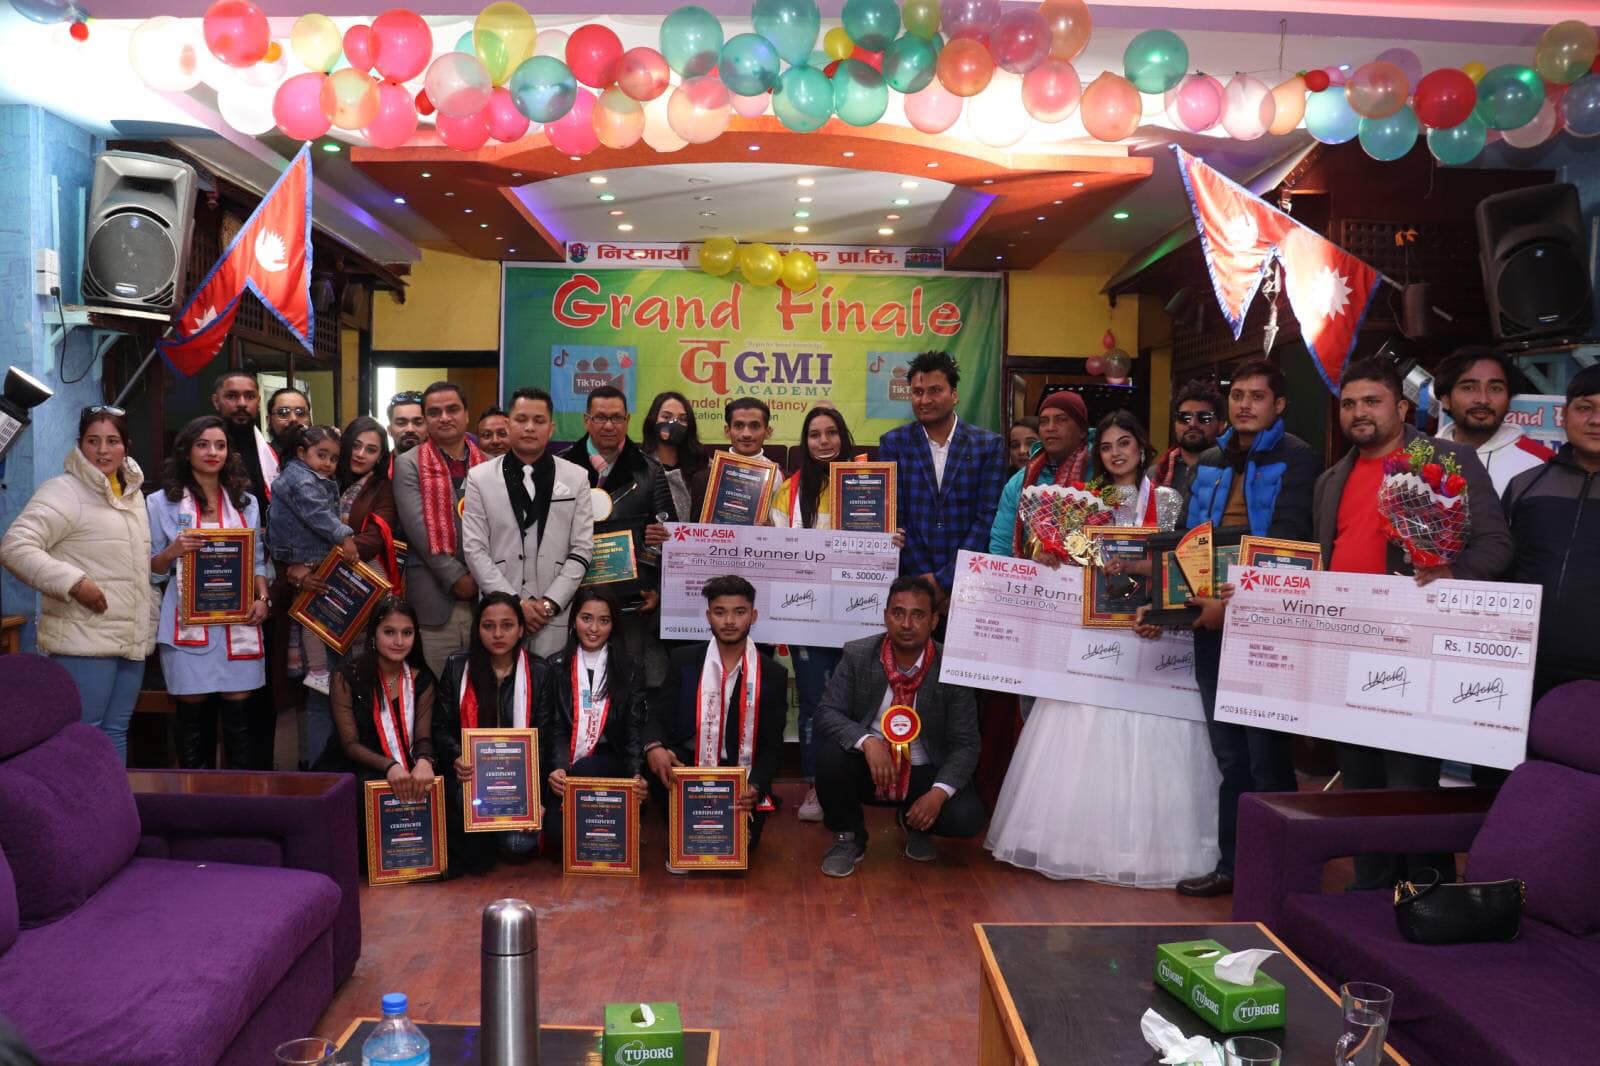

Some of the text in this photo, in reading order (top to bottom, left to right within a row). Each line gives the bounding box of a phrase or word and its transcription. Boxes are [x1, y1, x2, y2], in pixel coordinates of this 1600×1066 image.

[552, 273, 962, 337] Grand Finale
[734, 351, 833, 384] GMI
[576, 378, 607, 387] TikTok
[736, 385, 831, 396] ACADEMY
[1504, 408, 1544, 426] and
[692, 528, 736, 539] NIC ASIA
[708, 545, 826, 563] 2nd Runner Up
[709, 559, 746, 567] Thousand
[748, 560, 766, 569] Only
[990, 560, 1008, 572] NIC
[1011, 563, 1038, 577] ASIA
[841, 570, 888, 581] Rs. 50000/-
[1262, 574, 1311, 589] NIC ASIA
[1006, 581, 1083, 603] 1st Runn
[1038, 600, 1058, 611] Only
[1282, 599, 1346, 617] Winner
[1251, 613, 1386, 636] One Lakh Fifty Thousand Only
[1444, 639, 1525, 659] Rs. 150000/-
[1161, 964, 1184, 986] TUBORG
[1196, 989, 1219, 1015] TUBORG
[1240, 1003, 1280, 1018] TUBORG
[624, 1046, 674, 1062] TUBORG
